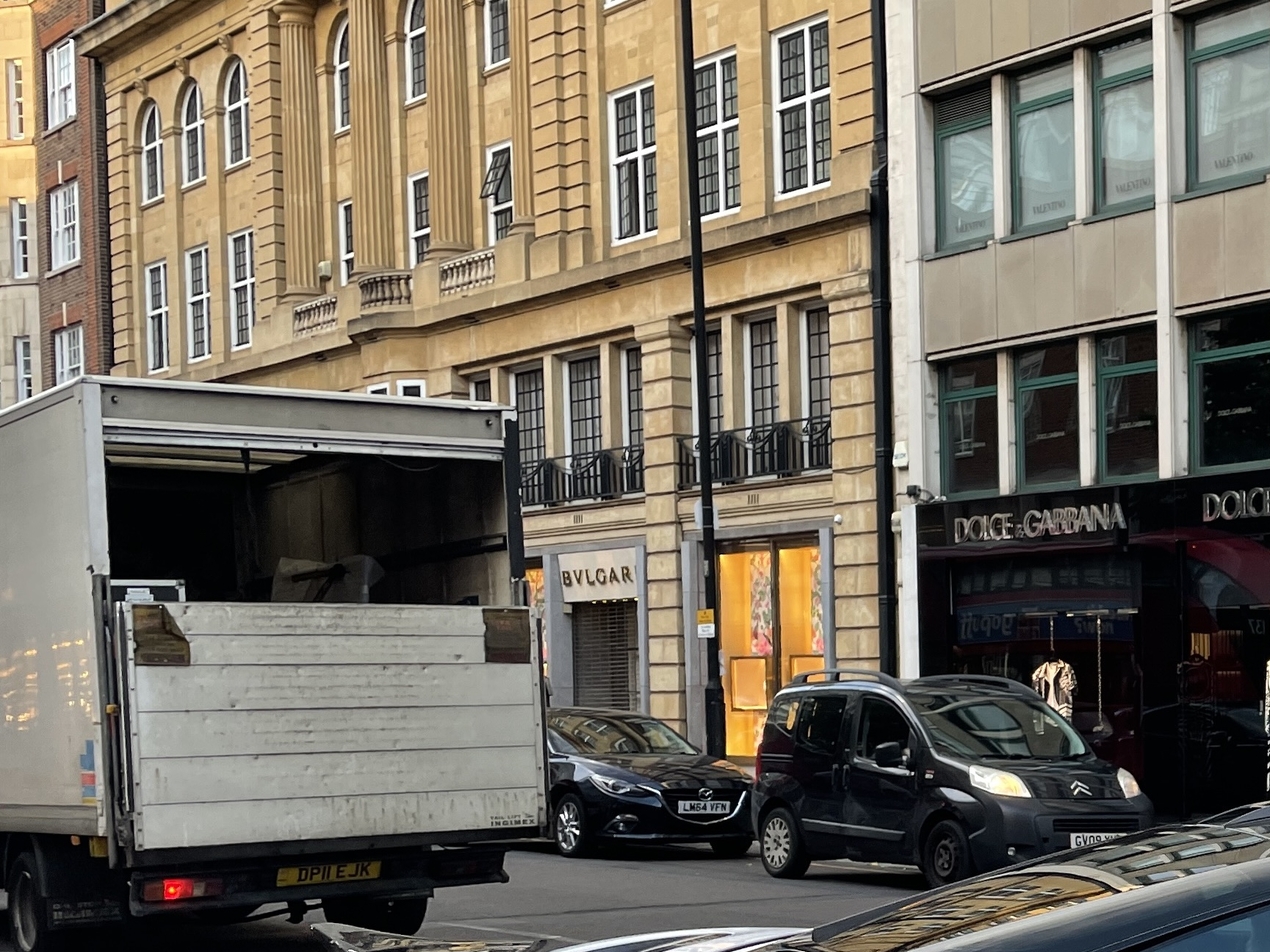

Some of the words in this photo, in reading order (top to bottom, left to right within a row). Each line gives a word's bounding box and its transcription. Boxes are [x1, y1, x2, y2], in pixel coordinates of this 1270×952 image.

[1214, 152, 1254, 169] VALENTINO
[562, 565, 637, 587] BVLGAR
[682, 802, 707, 812] LM64
[710, 802, 727, 812] VFN
[490, 819, 536, 827] INGIMEX
[298, 865, 332, 883] DP11
[336, 862, 372, 879] EJK
